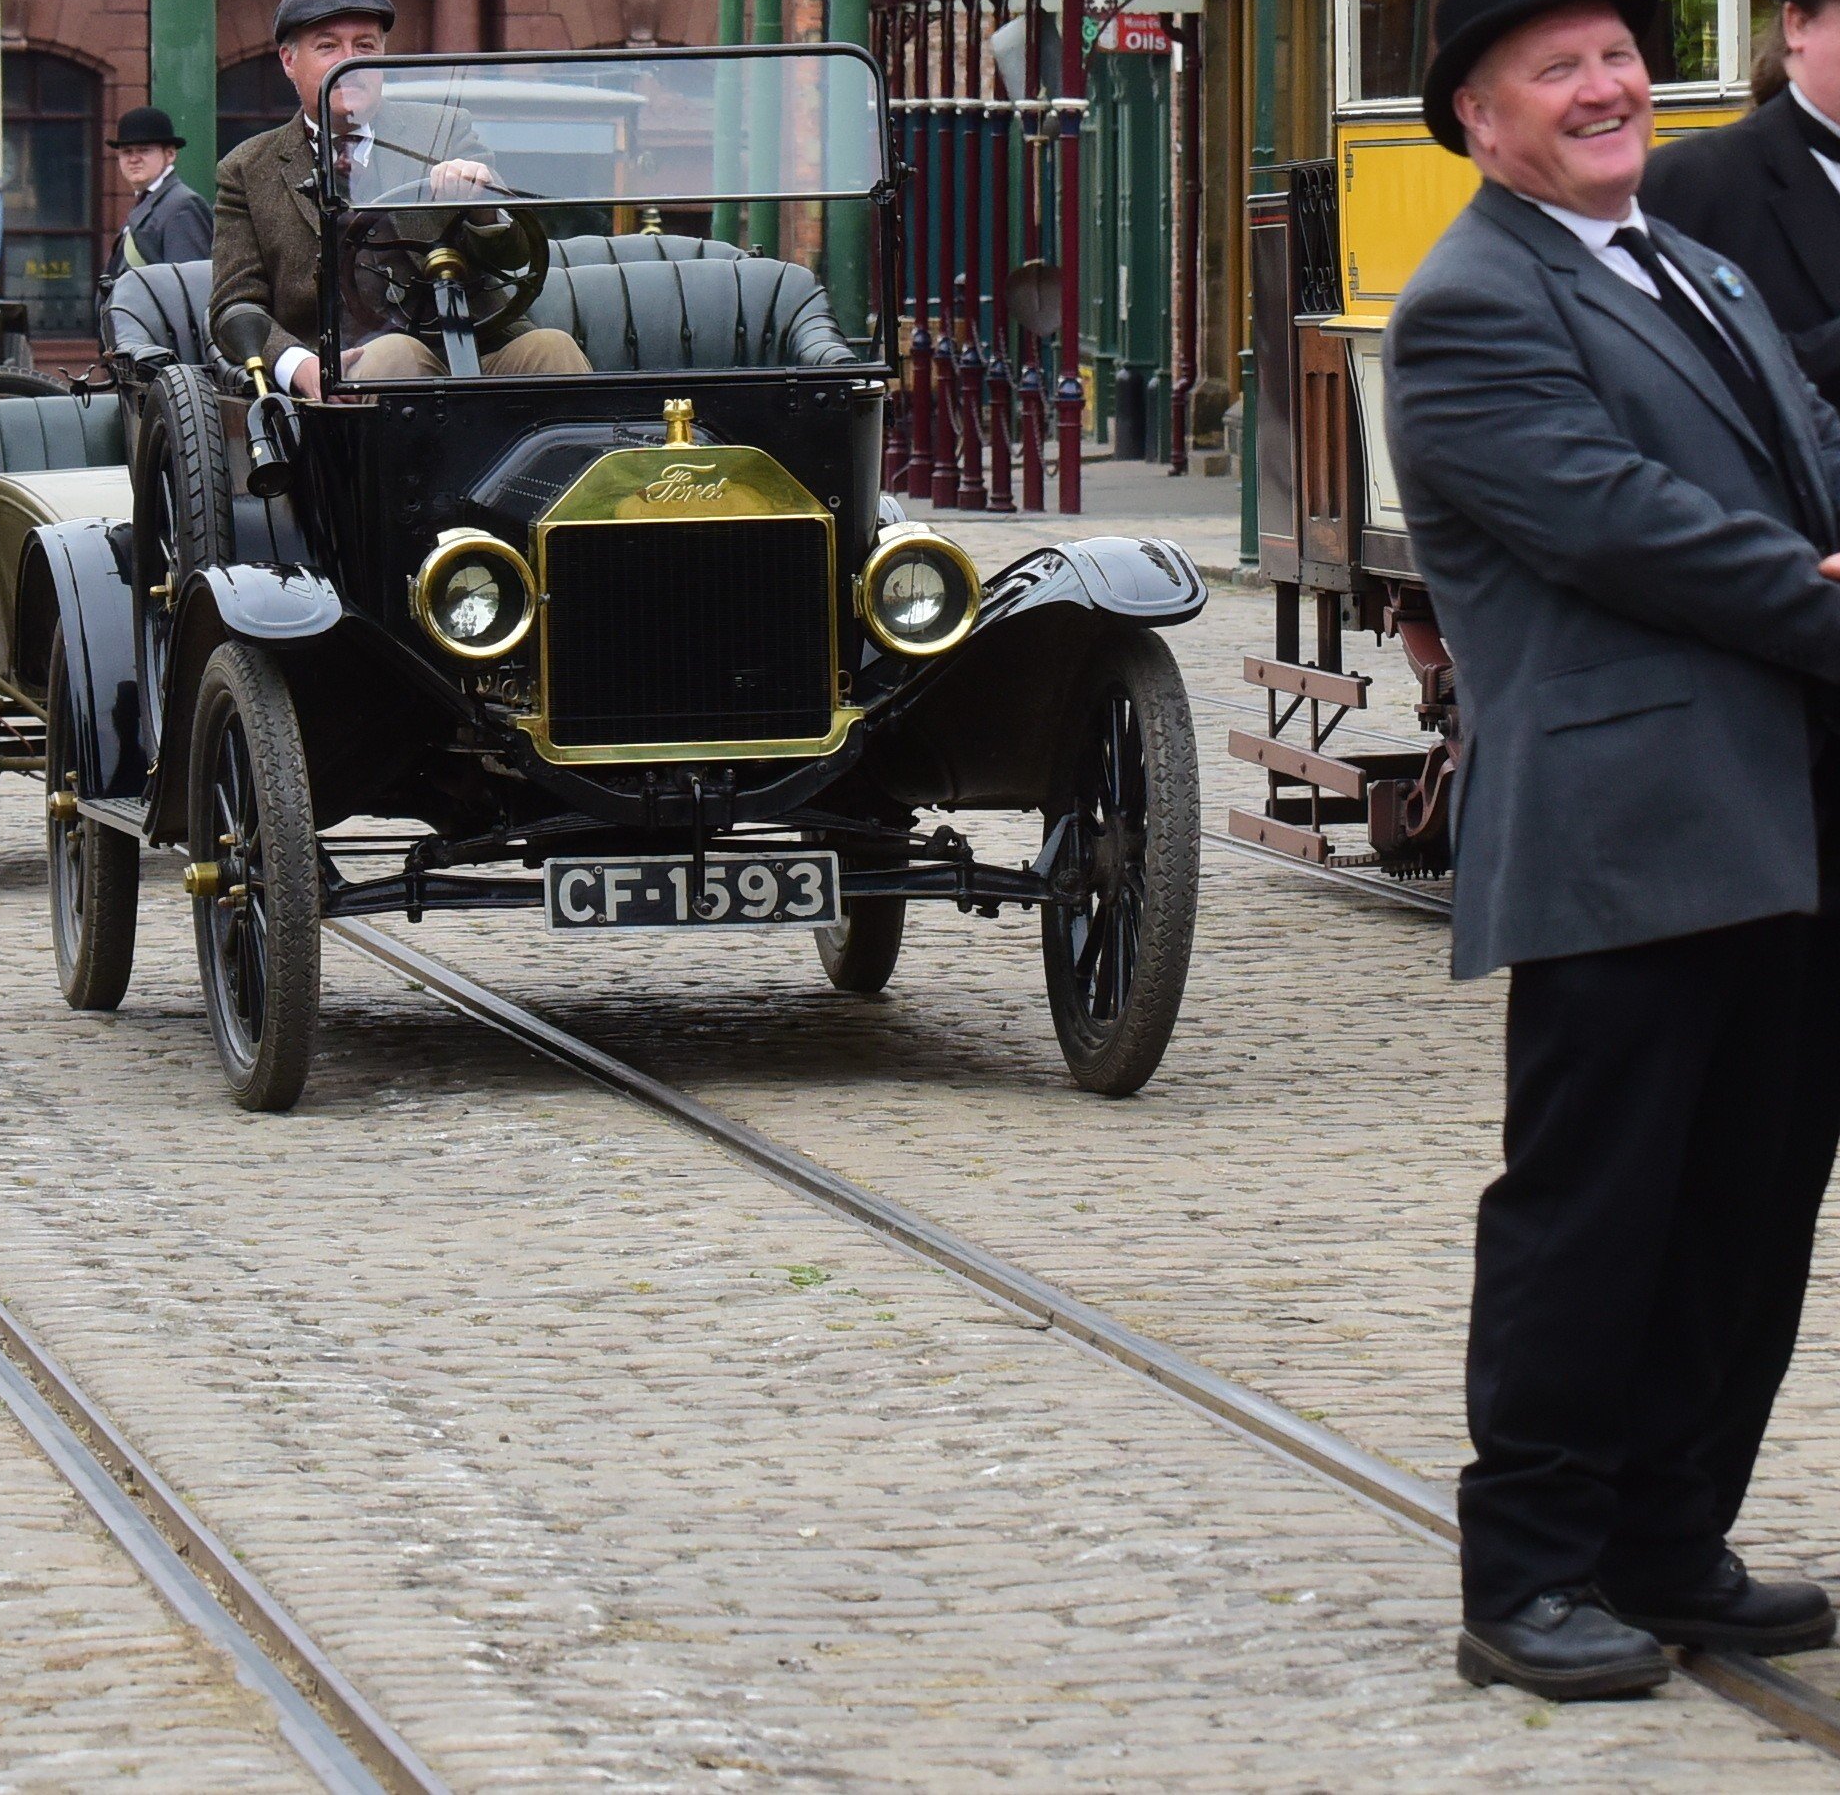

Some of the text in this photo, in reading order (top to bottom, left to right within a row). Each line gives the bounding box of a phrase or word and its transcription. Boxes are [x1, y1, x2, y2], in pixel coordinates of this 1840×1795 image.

[1125, 31, 1167, 51] Oils
[646, 463, 728, 503] Ford
[559, 862, 825, 923] CF-1593
